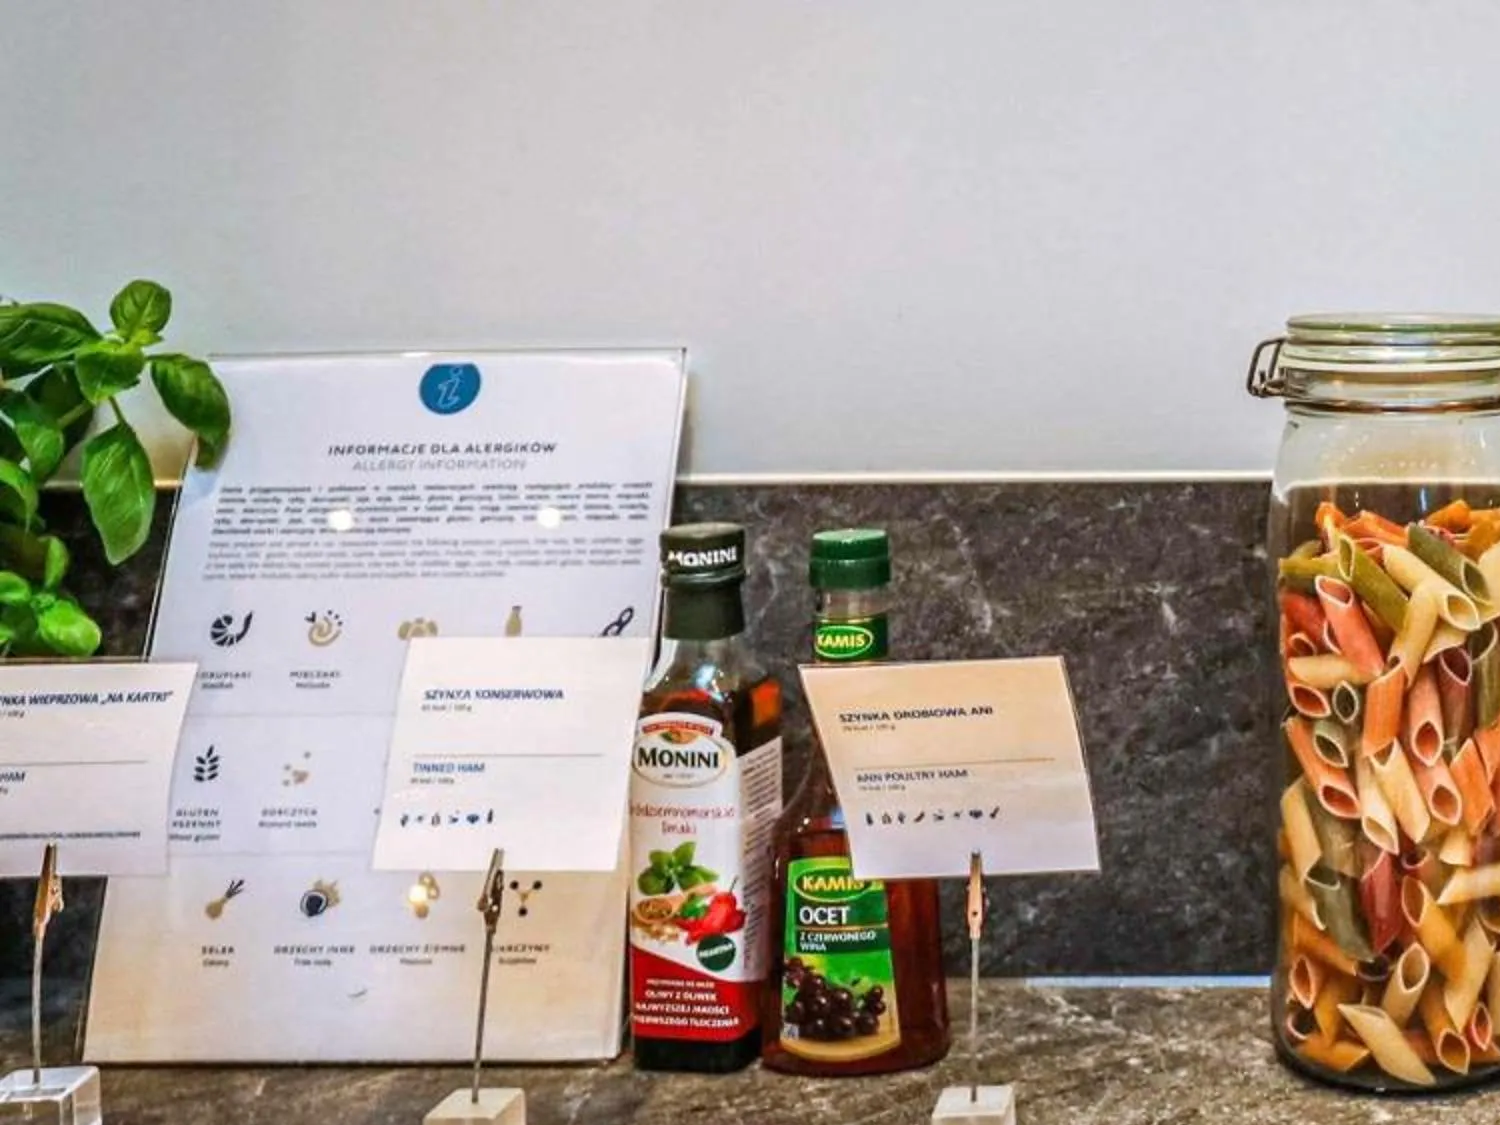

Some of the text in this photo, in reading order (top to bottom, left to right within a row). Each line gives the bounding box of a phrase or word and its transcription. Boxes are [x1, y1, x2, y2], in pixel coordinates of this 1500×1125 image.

[328, 443, 427, 456] INFORMACJE
[430, 443, 461, 455] DLA
[352, 457, 528, 472] ALLERGY INFORMATION
[668, 545, 737, 567] MONINI
[816, 633, 866, 648] KAMIS
[29, 692, 99, 705] WIEPRZOWA
[424, 687, 565, 700] SZYNKA KONSERWOWA
[839, 710, 890, 723] SZYNKA
[970, 705, 994, 716] ANI
[637, 746, 719, 769] MONINI
[413, 761, 486, 773] TINNED HAM
[884, 770, 935, 782] POULTRY
[939, 768, 969, 778] HAM
[802, 875, 865, 891] KAMIS
[799, 905, 851, 925] OCET
[807, 929, 877, 942] CZERWONEGO
[800, 942, 828, 952] WINA
[682, 991, 717, 1002] OLIWEK
